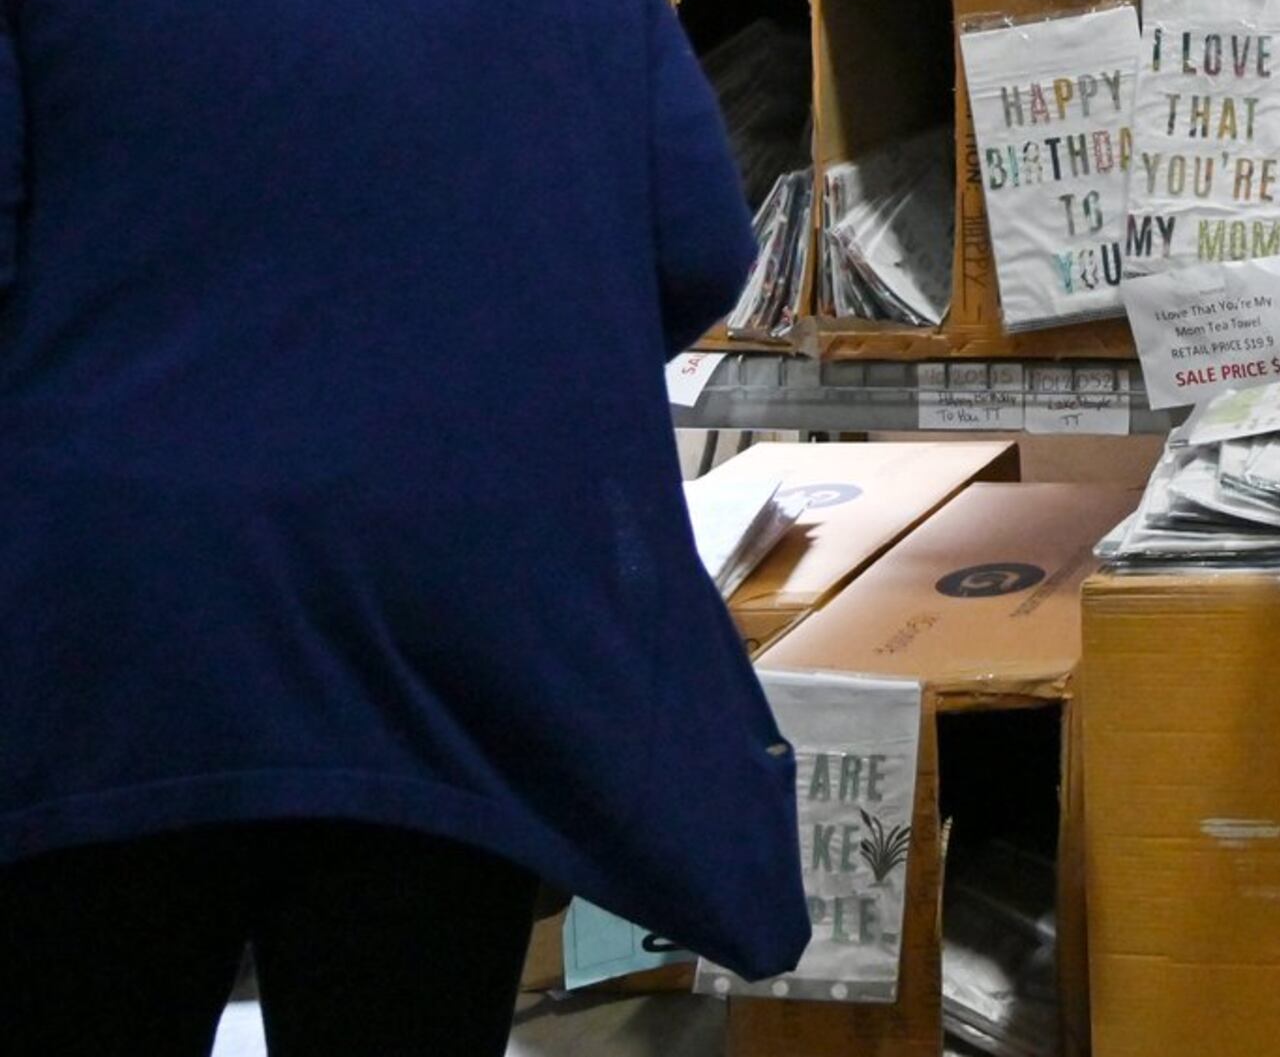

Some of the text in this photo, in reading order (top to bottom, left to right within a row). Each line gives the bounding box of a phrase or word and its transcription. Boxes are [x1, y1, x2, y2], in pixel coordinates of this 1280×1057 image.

[1182, 32, 1272, 78] LOVE
[1001, 69, 1122, 128] HAPPY
[1165, 93, 1260, 141] THAT
[1143, 150, 1279, 202] YOU'RE
[1060, 190, 1103, 237] TO
[1126, 215, 1177, 258] MY
[1053, 243, 1123, 295] YOU
[1161, 309, 1188, 322] Love
[1191, 304, 1217, 317] That
[1254, 295, 1272, 309] My
[1175, 316, 1261, 338] Mom Tea Towel
[1171, 340, 1241, 360] RETAIL PRICE
[1175, 361, 1267, 388] SALE PRICE
[808, 753, 887, 801] ARE
